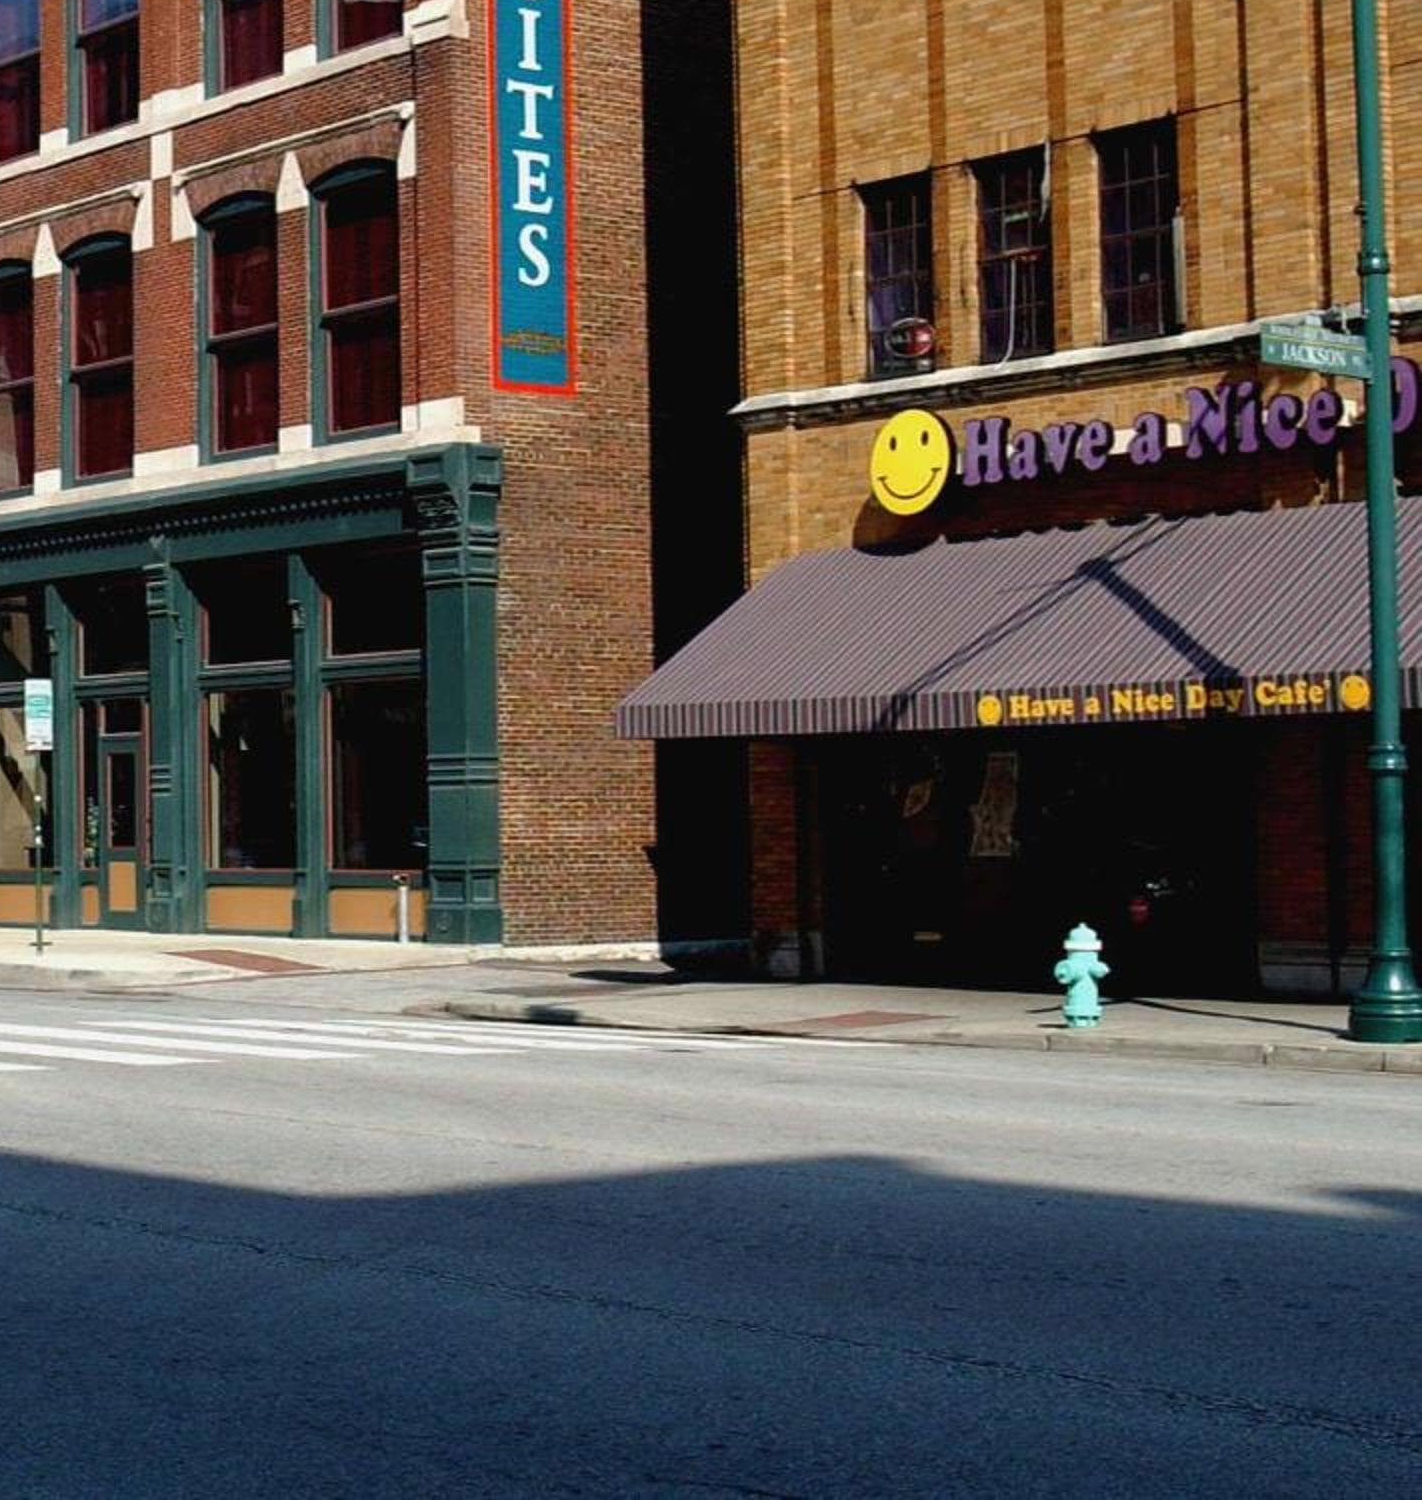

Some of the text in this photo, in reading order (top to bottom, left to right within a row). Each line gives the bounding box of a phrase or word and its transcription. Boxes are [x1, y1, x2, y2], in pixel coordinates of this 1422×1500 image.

[1282, 342, 1347, 367] JACKSON
[962, 418, 1110, 487] Have
[1129, 413, 1165, 465] a
[1186, 380, 1341, 459] Nice
[1008, 694, 1075, 719] Have
[1083, 696, 1101, 715] a
[1111, 688, 1175, 714] Nice
[1186, 681, 1245, 712] Day
